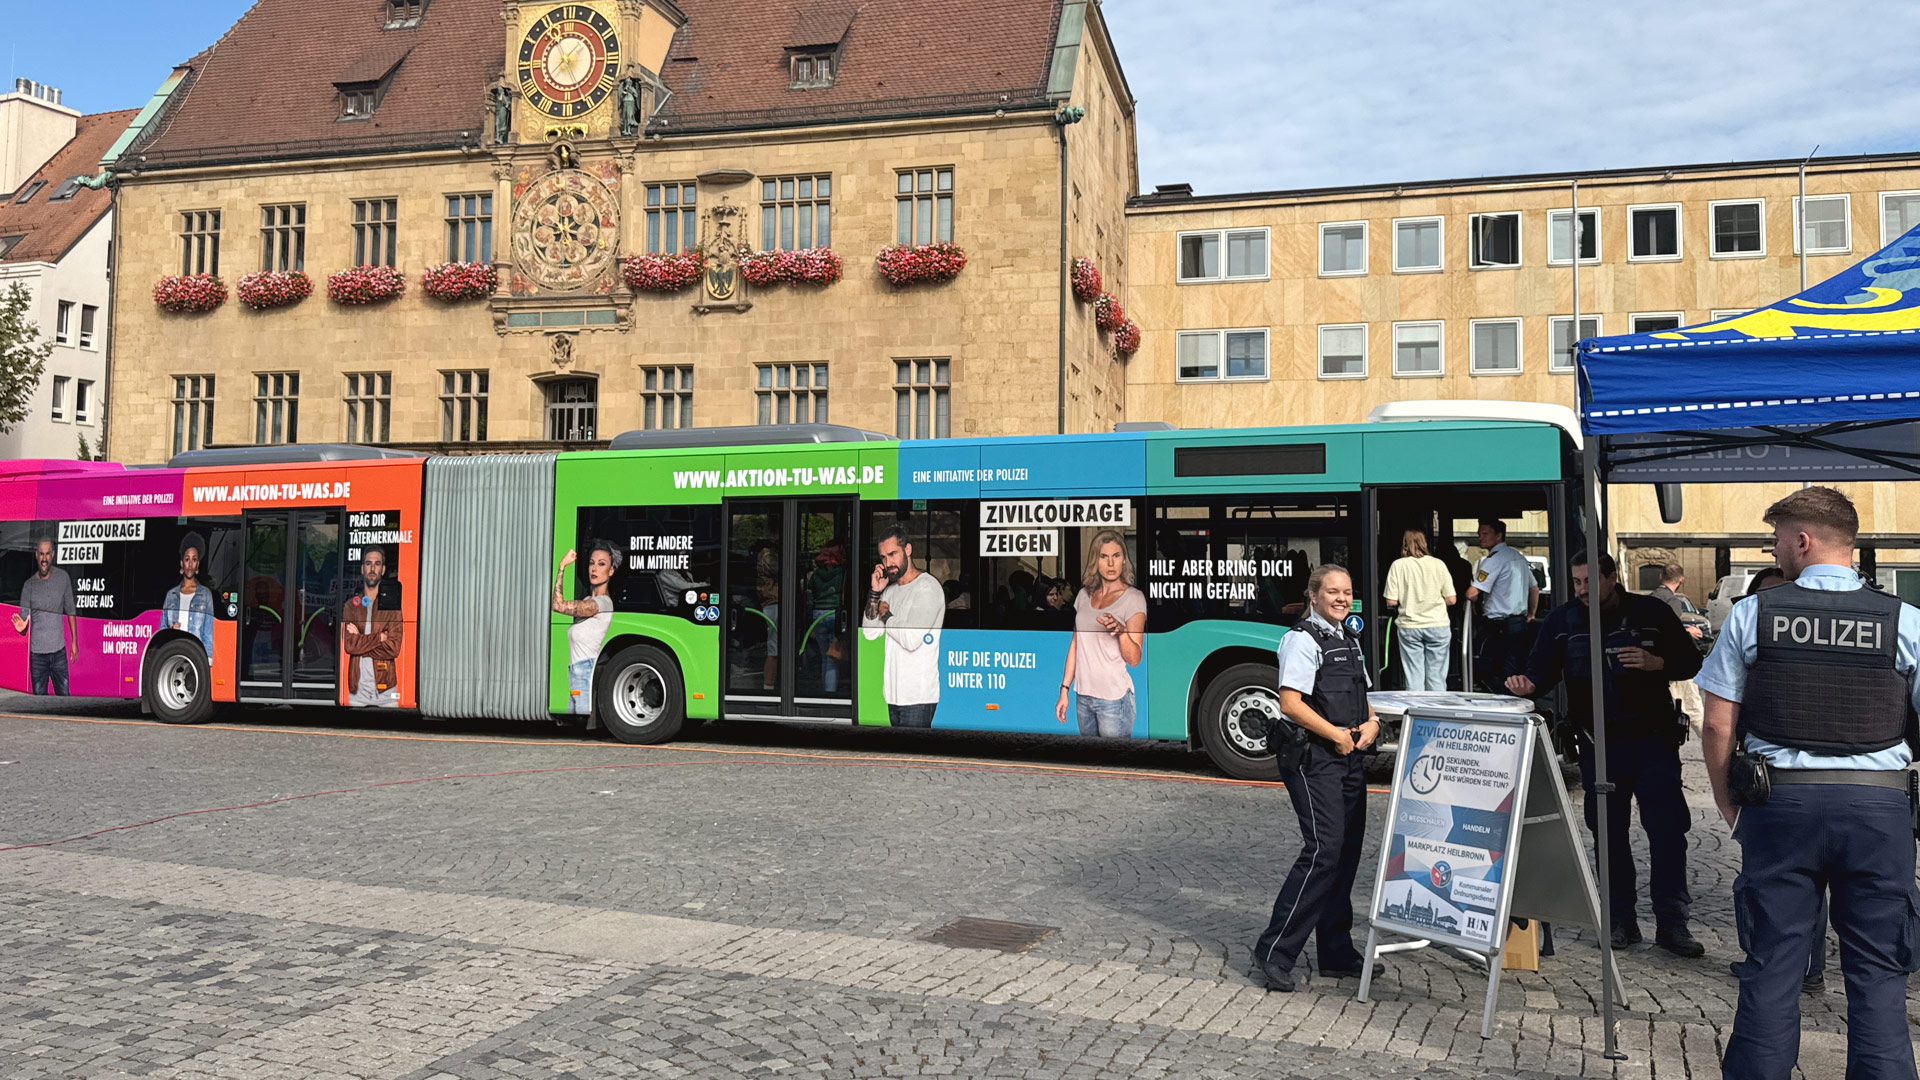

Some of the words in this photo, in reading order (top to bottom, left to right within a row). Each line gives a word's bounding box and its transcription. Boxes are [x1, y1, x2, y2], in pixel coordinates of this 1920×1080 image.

[673, 465, 884, 489] WWW.AKTION-TU-WAS.DE
[913, 471, 931, 483] EINE
[934, 470, 974, 482] INITIATIVE
[977, 469, 994, 482] DER
[996, 468, 1028, 481] POLIZEI
[103, 496, 115, 506] EINE
[116, 495, 141, 505] INITIATIVE
[142, 494, 152, 504] DER
[154, 493, 174, 504] POLIZEI
[193, 482, 350, 502] WWW.AKTION-TU-WAS.DE
[350, 512, 369, 527] PRÄG
[372, 514, 386, 527] DIR
[986, 503, 1124, 523] ZIVILCOURAGE
[63, 523, 141, 539] ZIVILCOURAGE
[350, 530, 413, 544] TÄTERMERKMALE
[630, 536, 654, 550] BITTE
[657, 536, 693, 550] ANDERE
[986, 534, 1052, 552] ZEIGEN
[62, 547, 99, 561] ZEIGEN
[348, 548, 361, 561] EIN
[630, 555, 644, 570] UM
[647, 555, 689, 570] MITHILFE
[1150, 560, 1175, 576] HILF
[1182, 560, 1213, 576] ABER
[1218, 560, 1257, 577] BRING
[1262, 560, 1292, 577] DICH
[77, 579, 91, 592] SAG
[92, 578, 105, 591] ALS
[1150, 582, 1186, 598] NICHT
[1189, 583, 1202, 599] IN
[1206, 583, 1255, 599] GEFAHR
[76, 595, 99, 608] ZEUGE
[100, 595, 114, 608] AUS
[103, 622, 134, 638] KÜMMER
[135, 625, 152, 638] DICH
[1772, 615, 1882, 649] POLIZEI
[103, 641, 114, 653] UM
[116, 642, 137, 654] OPFER
[948, 651, 969, 666] RUF
[973, 652, 991, 667] DIE
[994, 652, 1036, 669] POLIZEI
[948, 672, 983, 689] UNTER
[987, 673, 1006, 689] 110
[1417, 726, 1516, 745] ZIVILCOURAGETAG
[1446, 741, 1490, 753] HEILBRONN
[1430, 755, 1444, 771] 10
[1445, 765, 1458, 773] EINE
[1457, 776, 1480, 785] WÜRDEN
[1493, 781, 1509, 789] TUN?
[1463, 824, 1490, 834] HANDELN
[1408, 841, 1446, 854] MARKPLATZ
[1447, 848, 1485, 861] HEILBRONN
[1459, 882, 1492, 893] Kommunaler
